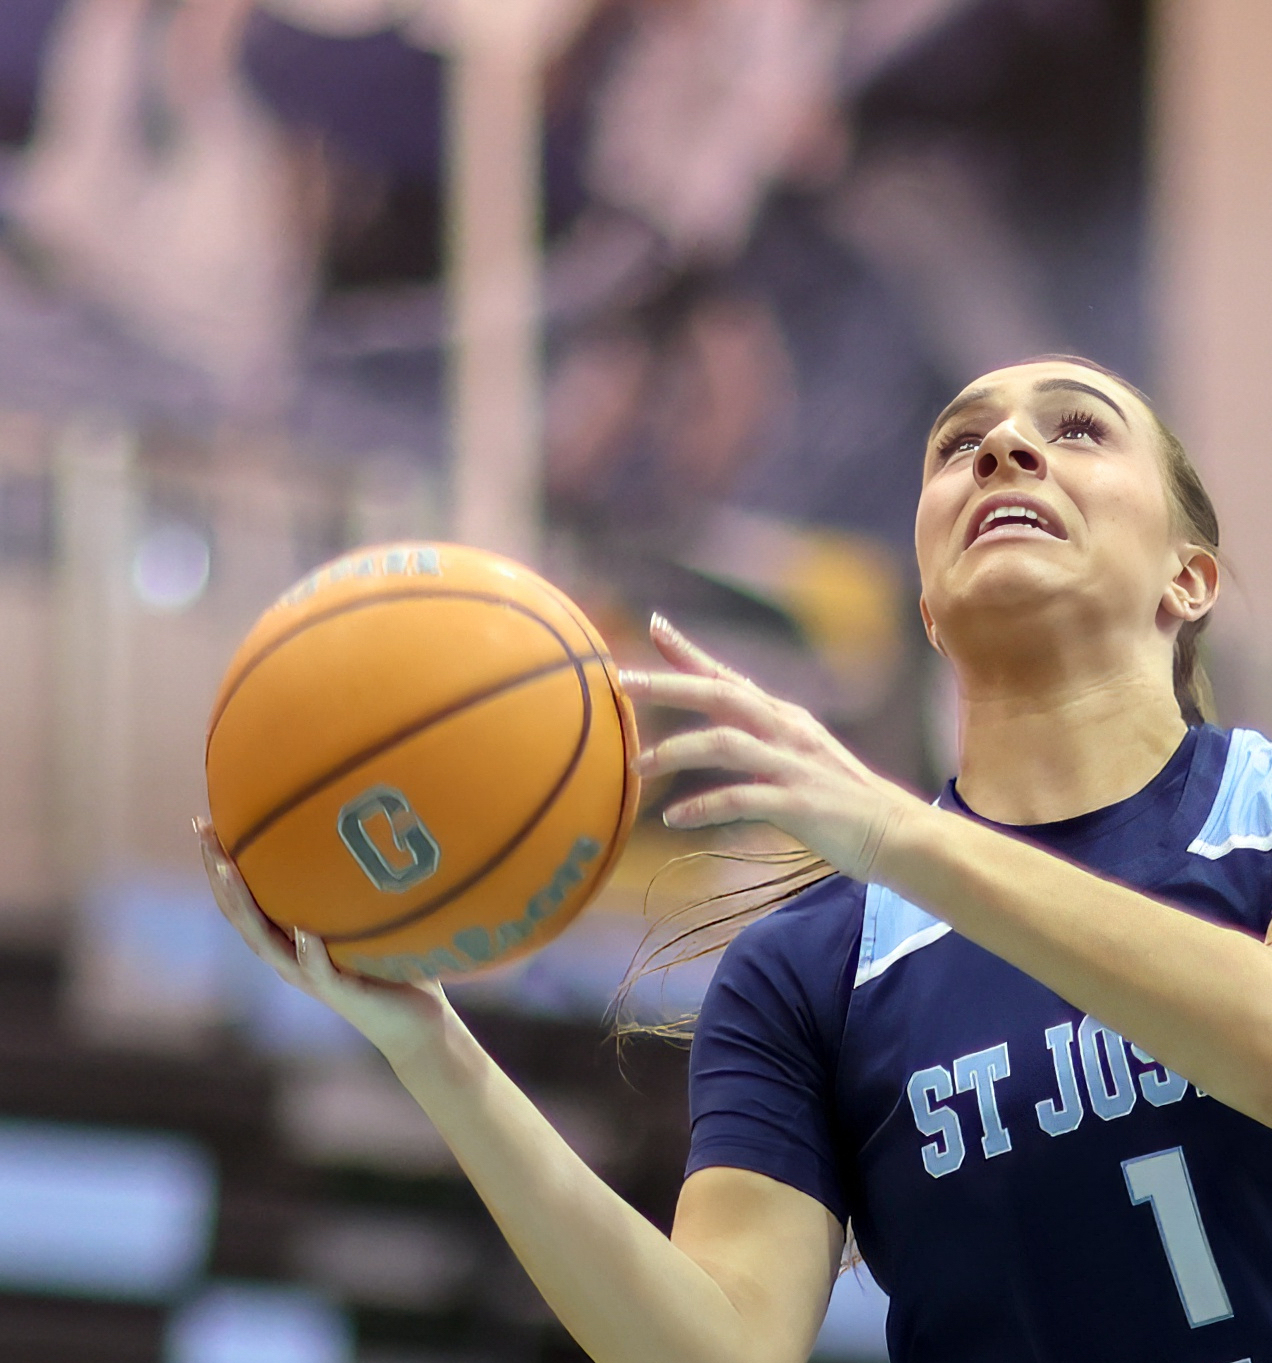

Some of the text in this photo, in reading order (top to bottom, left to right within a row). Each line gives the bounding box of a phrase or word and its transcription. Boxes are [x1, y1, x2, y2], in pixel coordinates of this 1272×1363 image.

[906, 1013, 1209, 1179] ST JOS
[1119, 1145, 1235, 1330] 1
